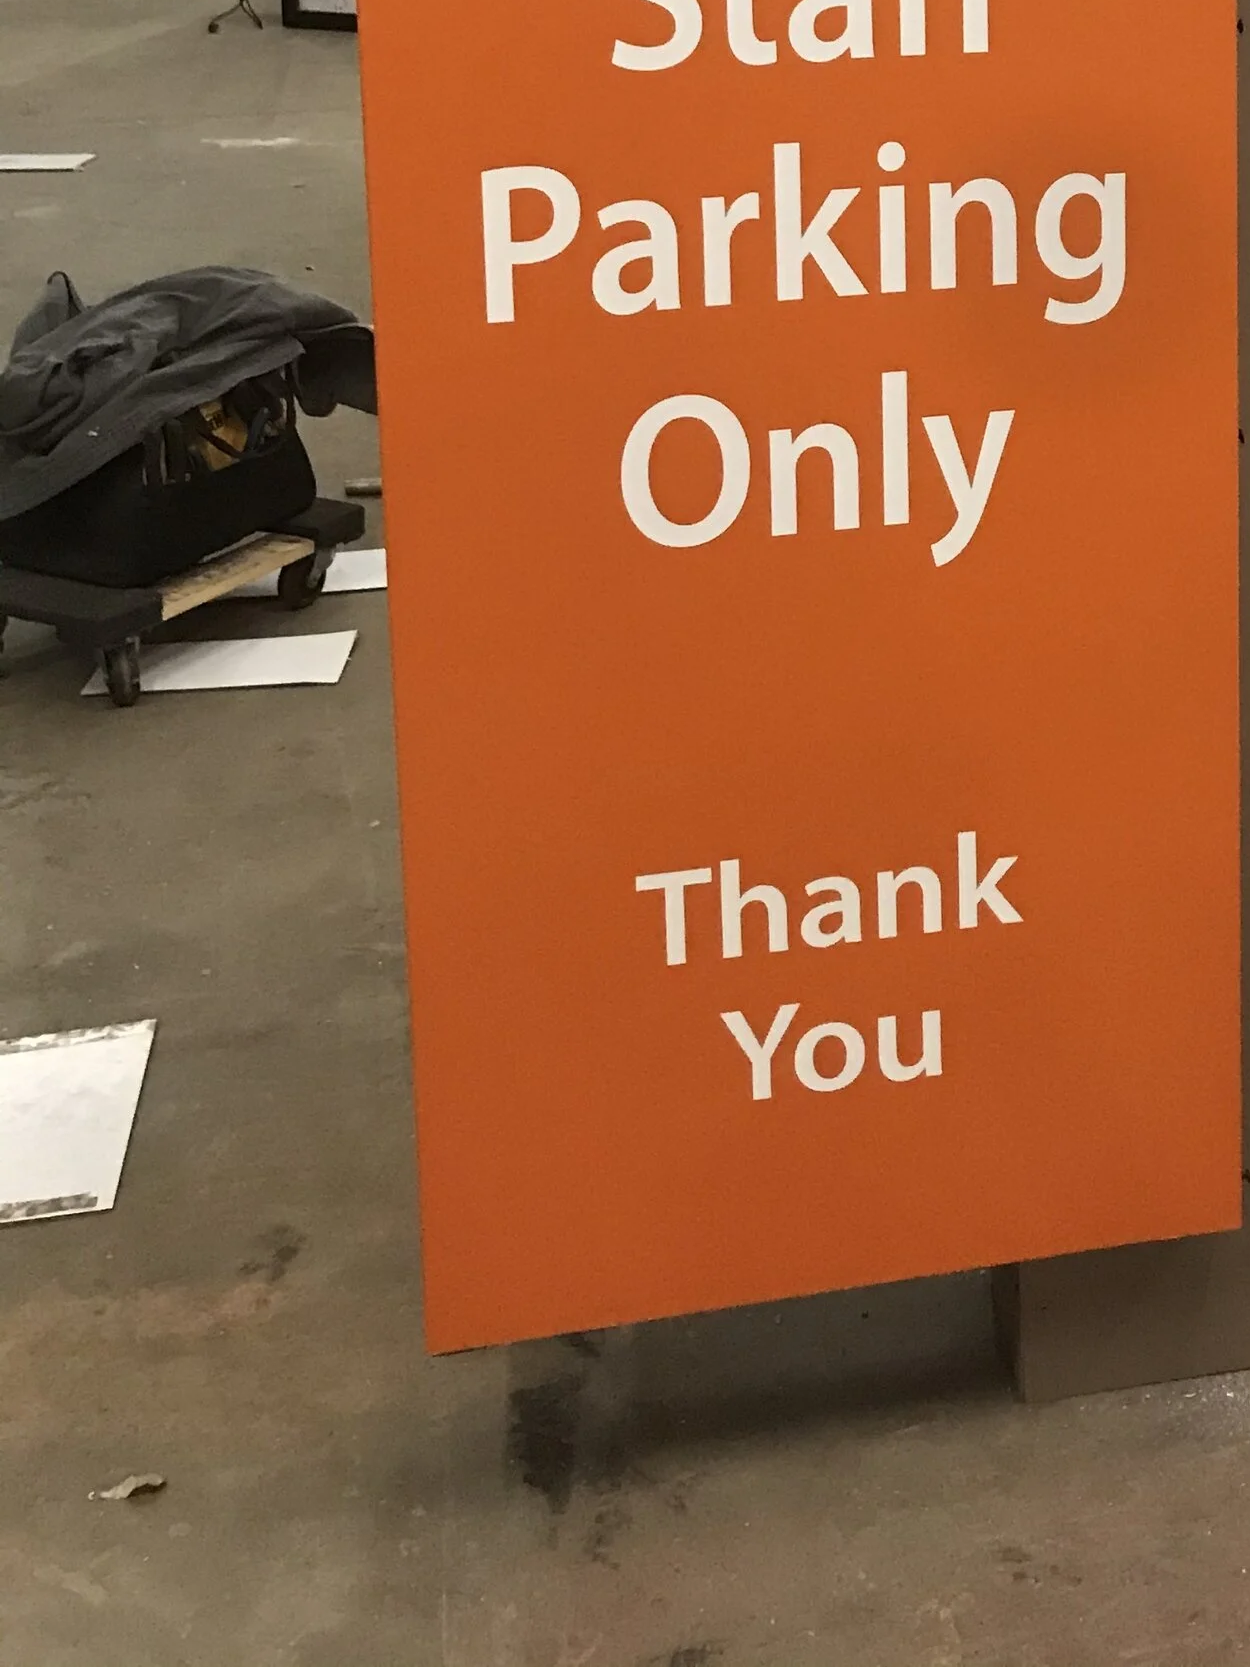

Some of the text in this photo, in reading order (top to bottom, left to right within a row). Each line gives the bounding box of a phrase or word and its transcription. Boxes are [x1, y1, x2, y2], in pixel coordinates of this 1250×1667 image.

[481, 142, 1125, 324] Parking
[621, 371, 1015, 566] Only
[636, 832, 1023, 965] Thank
[721, 1004, 942, 1100] You
